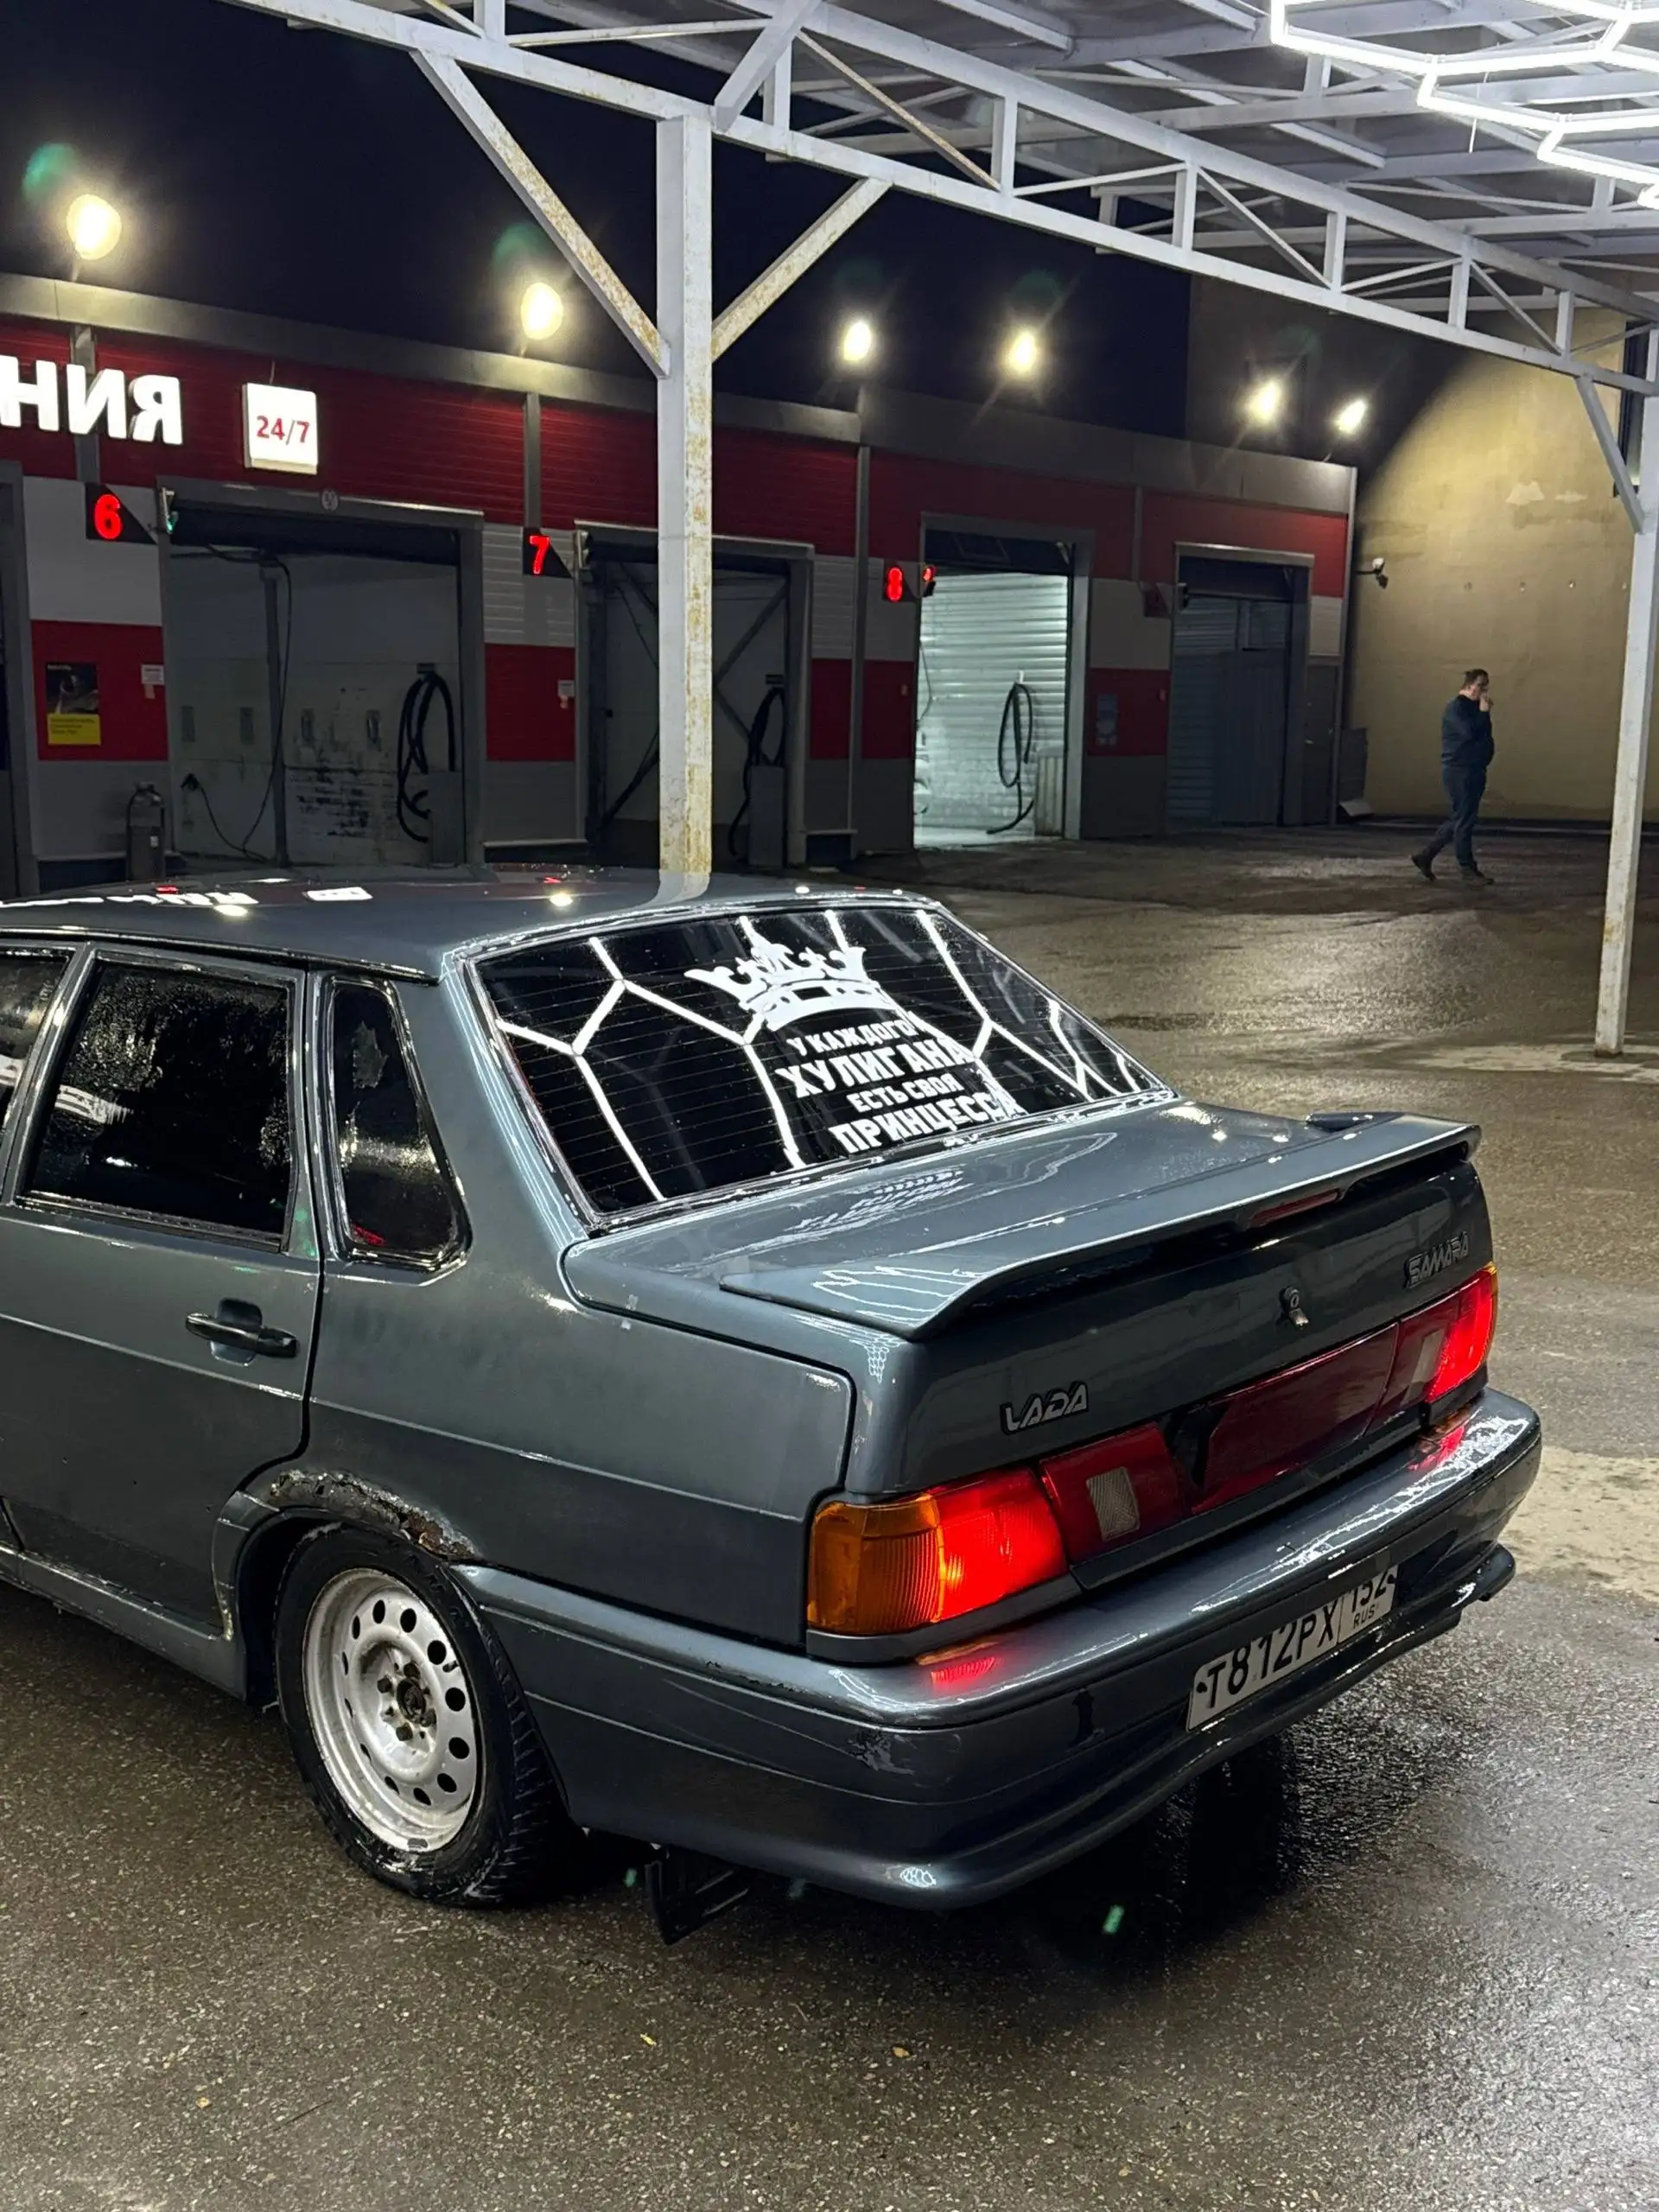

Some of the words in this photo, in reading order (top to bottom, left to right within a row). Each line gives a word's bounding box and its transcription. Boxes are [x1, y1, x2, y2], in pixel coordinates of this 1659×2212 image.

[257, 415, 310, 447] 24/7
[93, 493, 123, 540] 6
[529, 534, 550, 575] 7
[887, 567, 903, 602] 8
[785, 1037, 808, 1057] У
[804, 1019, 919, 1053] КАЖДОГО
[775, 1038, 976, 1098] ХУЛИГАНА
[846, 1085, 909, 1113] ЕСТЬ
[901, 1072, 965, 1100] СВОЯ
[1405, 1230, 1469, 1289] SAMARA
[1001, 1382, 1089, 1433] LADA
[1353, 1603, 1376, 1630] RUS
